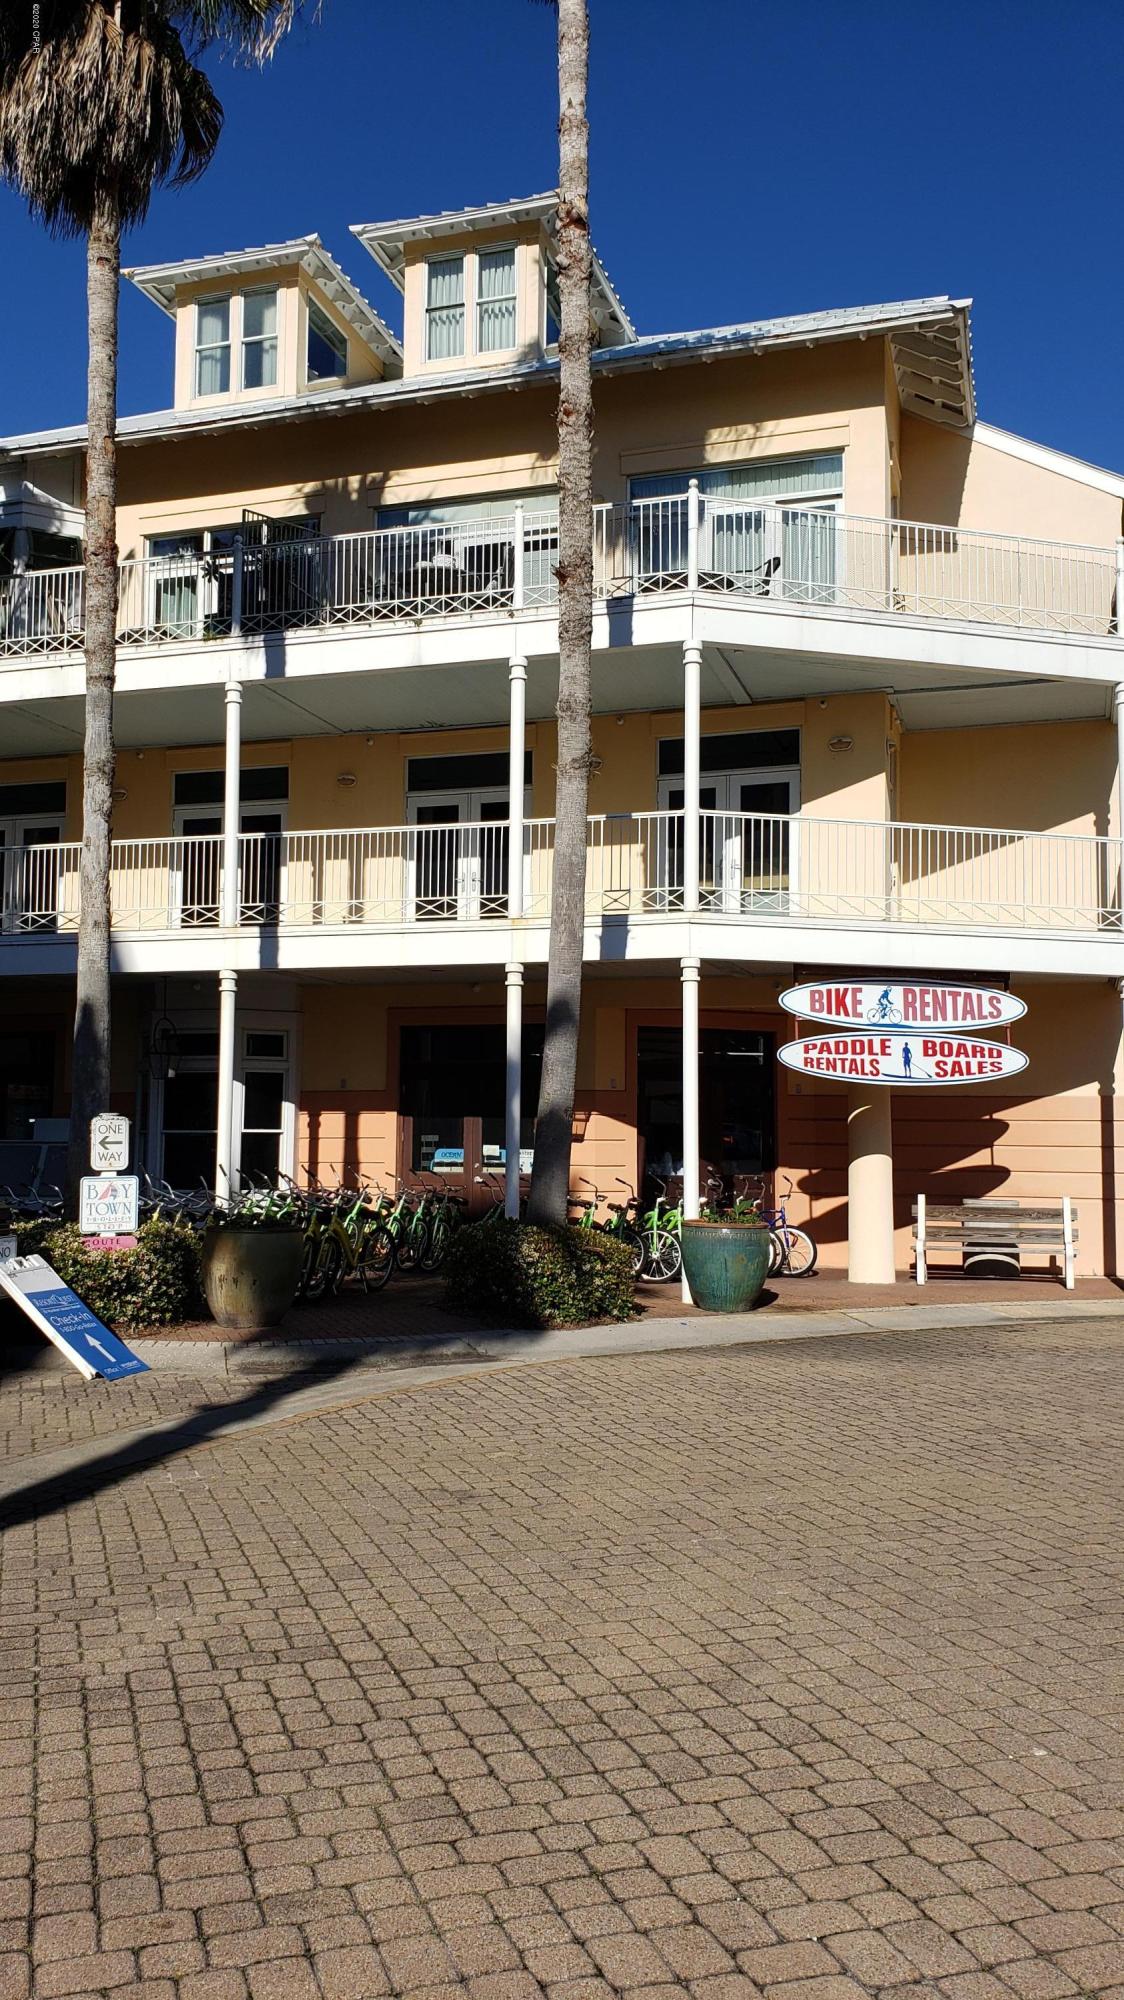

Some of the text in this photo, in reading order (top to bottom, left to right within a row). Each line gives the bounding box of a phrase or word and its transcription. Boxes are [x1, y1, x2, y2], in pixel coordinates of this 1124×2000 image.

[809, 987, 1002, 1022] BIKE RENTALS
[803, 1039, 1003, 1059] PADDLE BOARD
[803, 1057, 1003, 1078] RENTALS SALES
[98, 1124, 123, 1134] ONE
[97, 1151, 123, 1161] WAY
[86, 1202, 132, 1216] TOWN
[50, 1312, 92, 1326] Check-in
